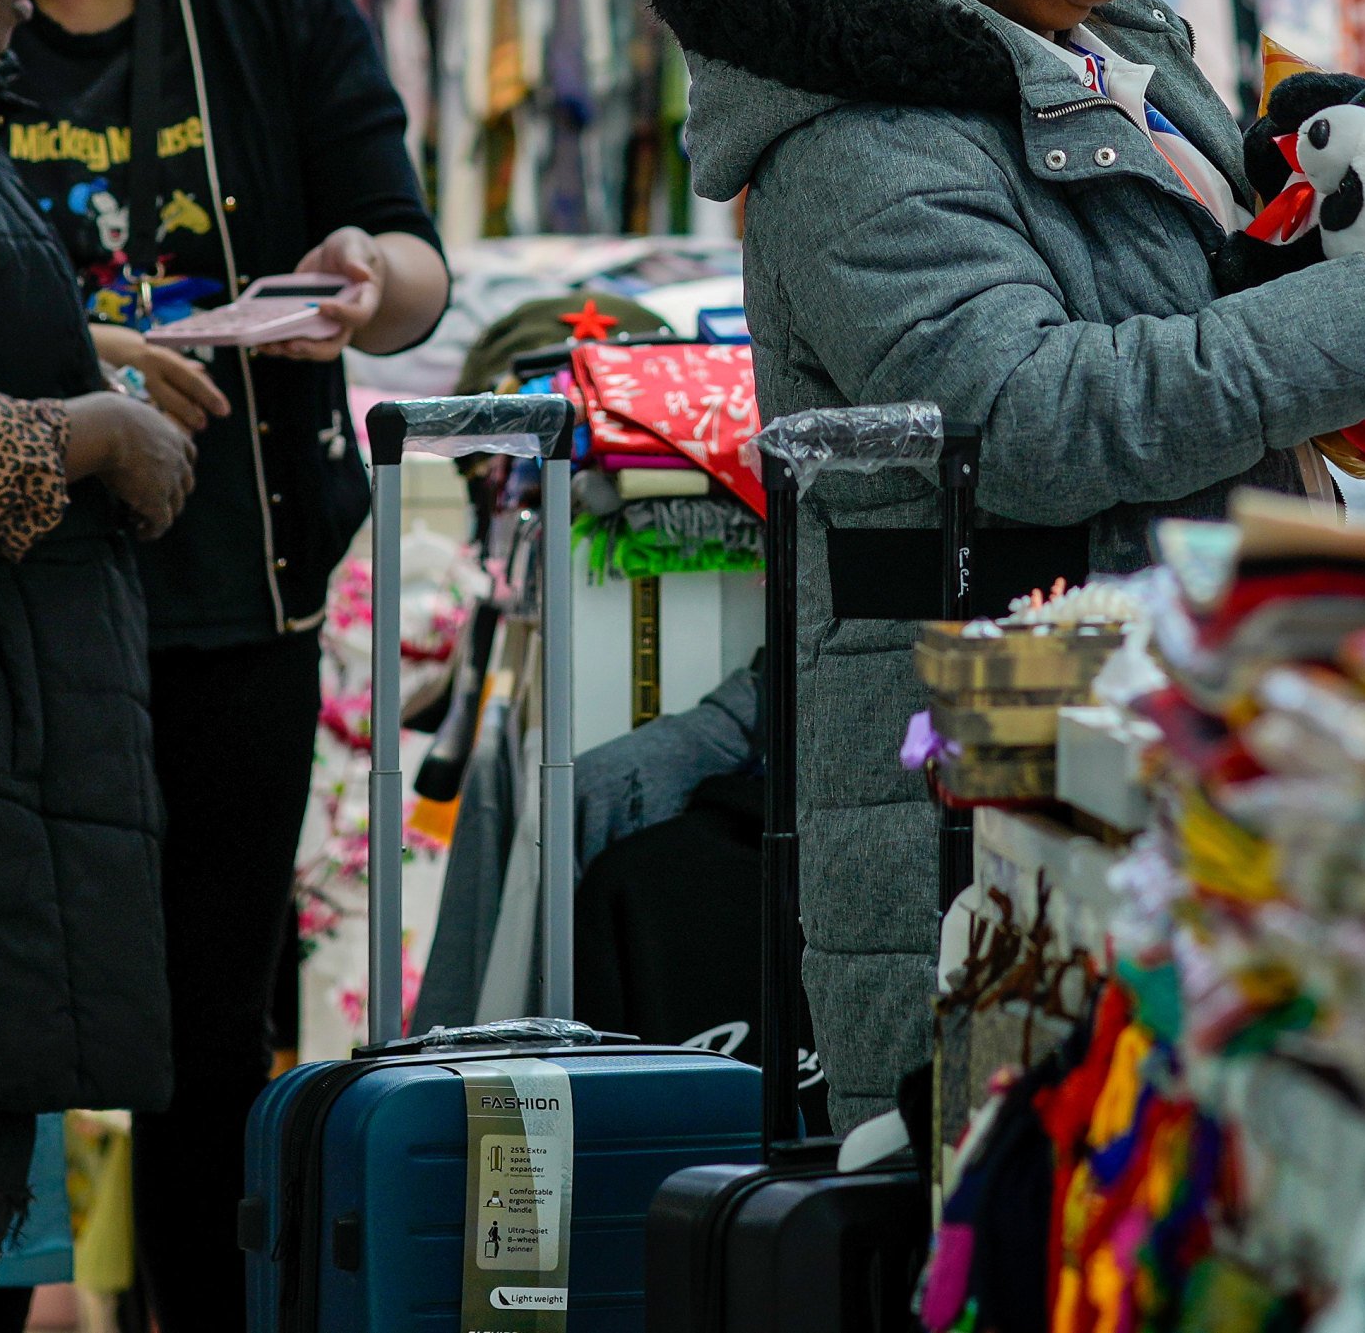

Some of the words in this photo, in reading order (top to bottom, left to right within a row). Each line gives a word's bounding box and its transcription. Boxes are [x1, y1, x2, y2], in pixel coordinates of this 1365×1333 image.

[9, 120, 110, 172] Mickey
[106, 116, 205, 165] Muse
[481, 1096, 560, 1111] FASHION
[509, 1188, 553, 1196] Comfortable
[507, 1227, 549, 1235] Ultra-quiet
[507, 1236, 539, 1244] 8-wheel
[511, 1294, 533, 1304] Light
[534, 1295, 564, 1304] weight
